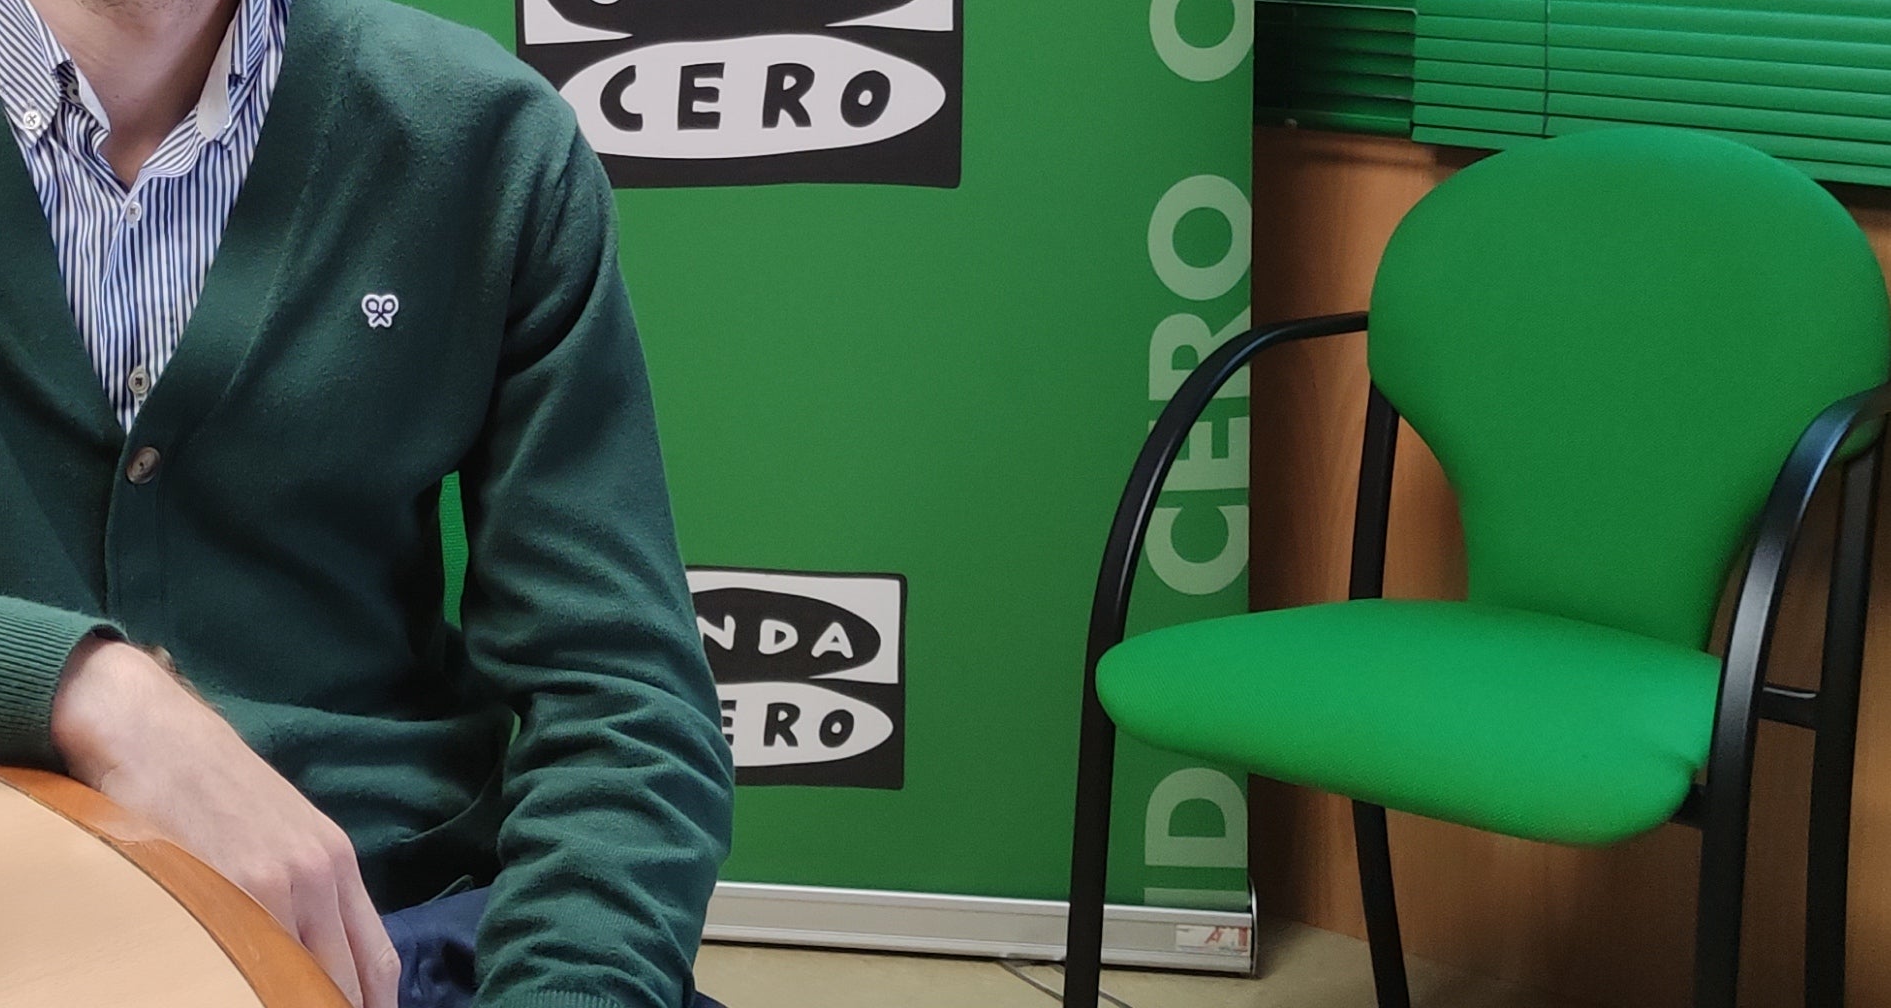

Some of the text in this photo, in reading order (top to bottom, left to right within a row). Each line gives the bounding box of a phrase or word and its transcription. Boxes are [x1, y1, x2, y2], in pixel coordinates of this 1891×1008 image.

[599, 62, 891, 132] CERO
[1144, 173, 1253, 596] CERO
[696, 614, 854, 659] NDA
